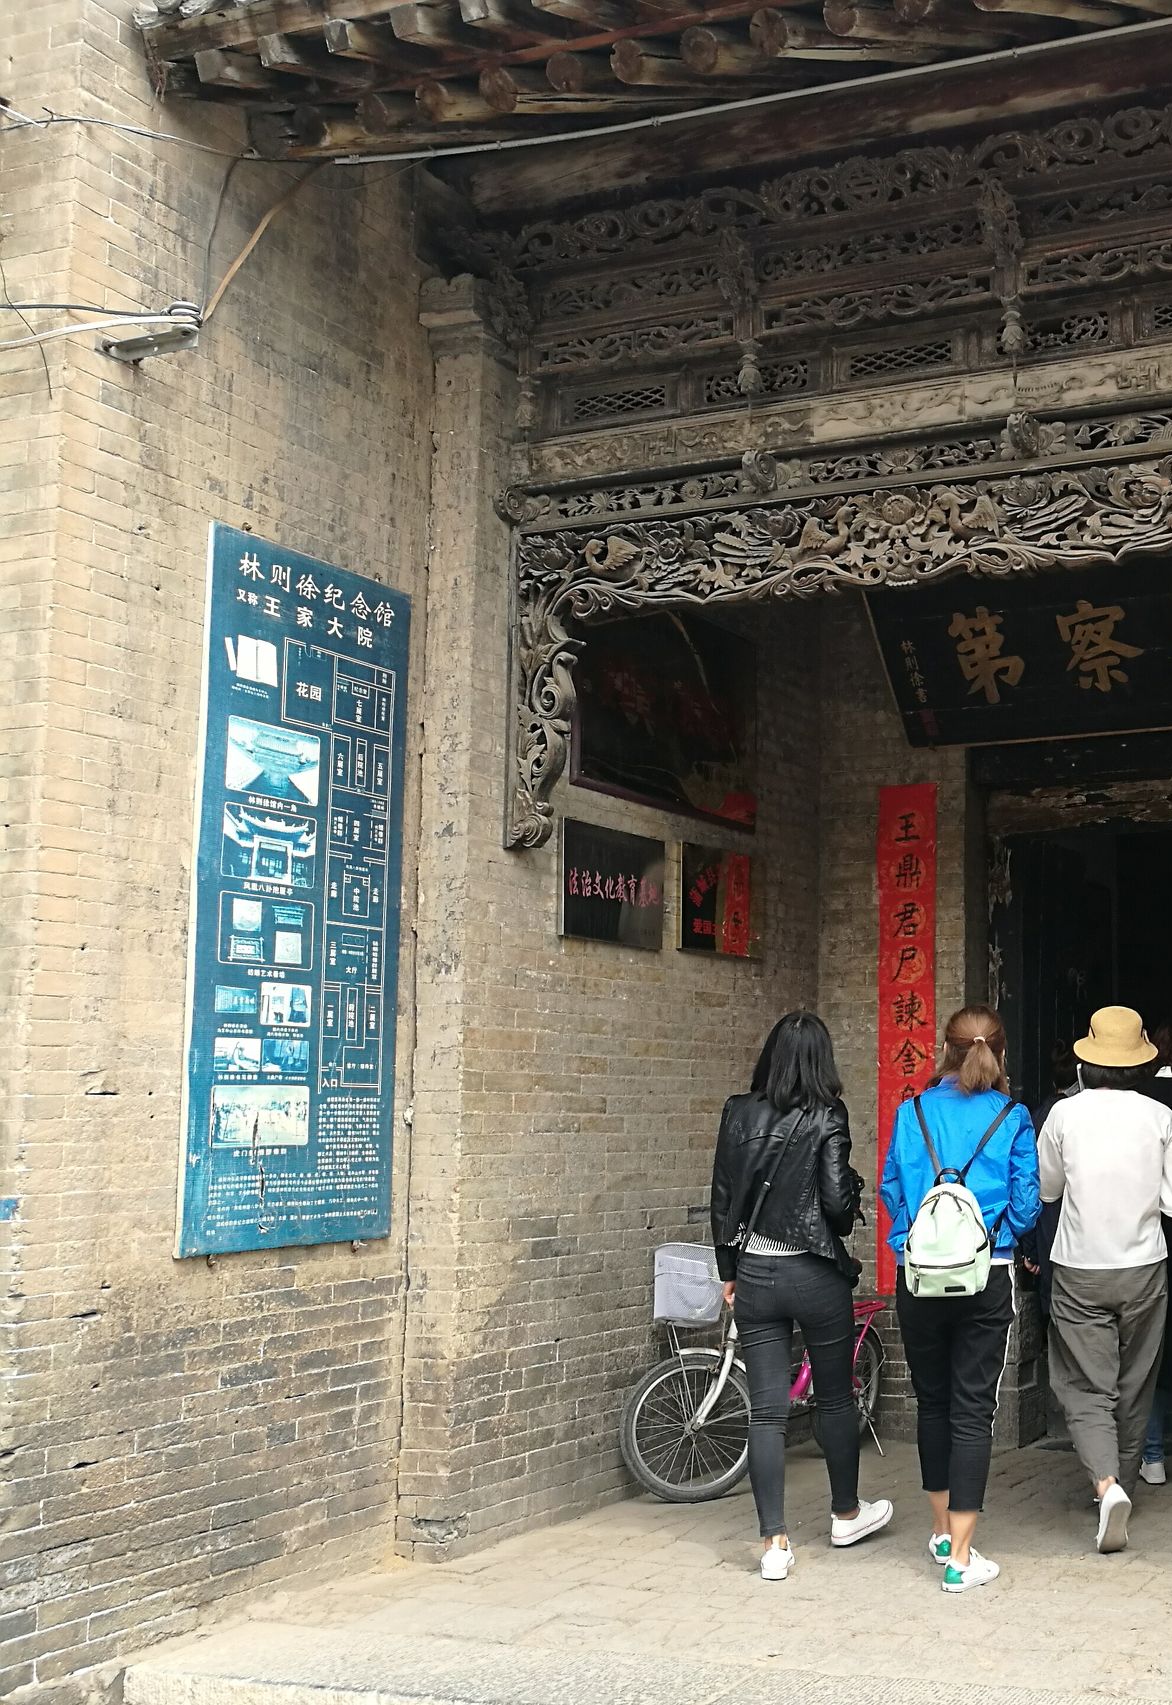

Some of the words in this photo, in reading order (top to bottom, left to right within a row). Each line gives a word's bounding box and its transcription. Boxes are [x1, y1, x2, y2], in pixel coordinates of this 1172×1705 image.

[238, 551, 395, 627] 林则徐纪念馆
[236, 588, 259, 608] 又称
[263, 595, 374, 650] 王家大院
[295, 681, 322, 702] 花园
[567, 866, 661, 908] 法治文化教育基地
[321, 1077, 338, 1088] 入口
